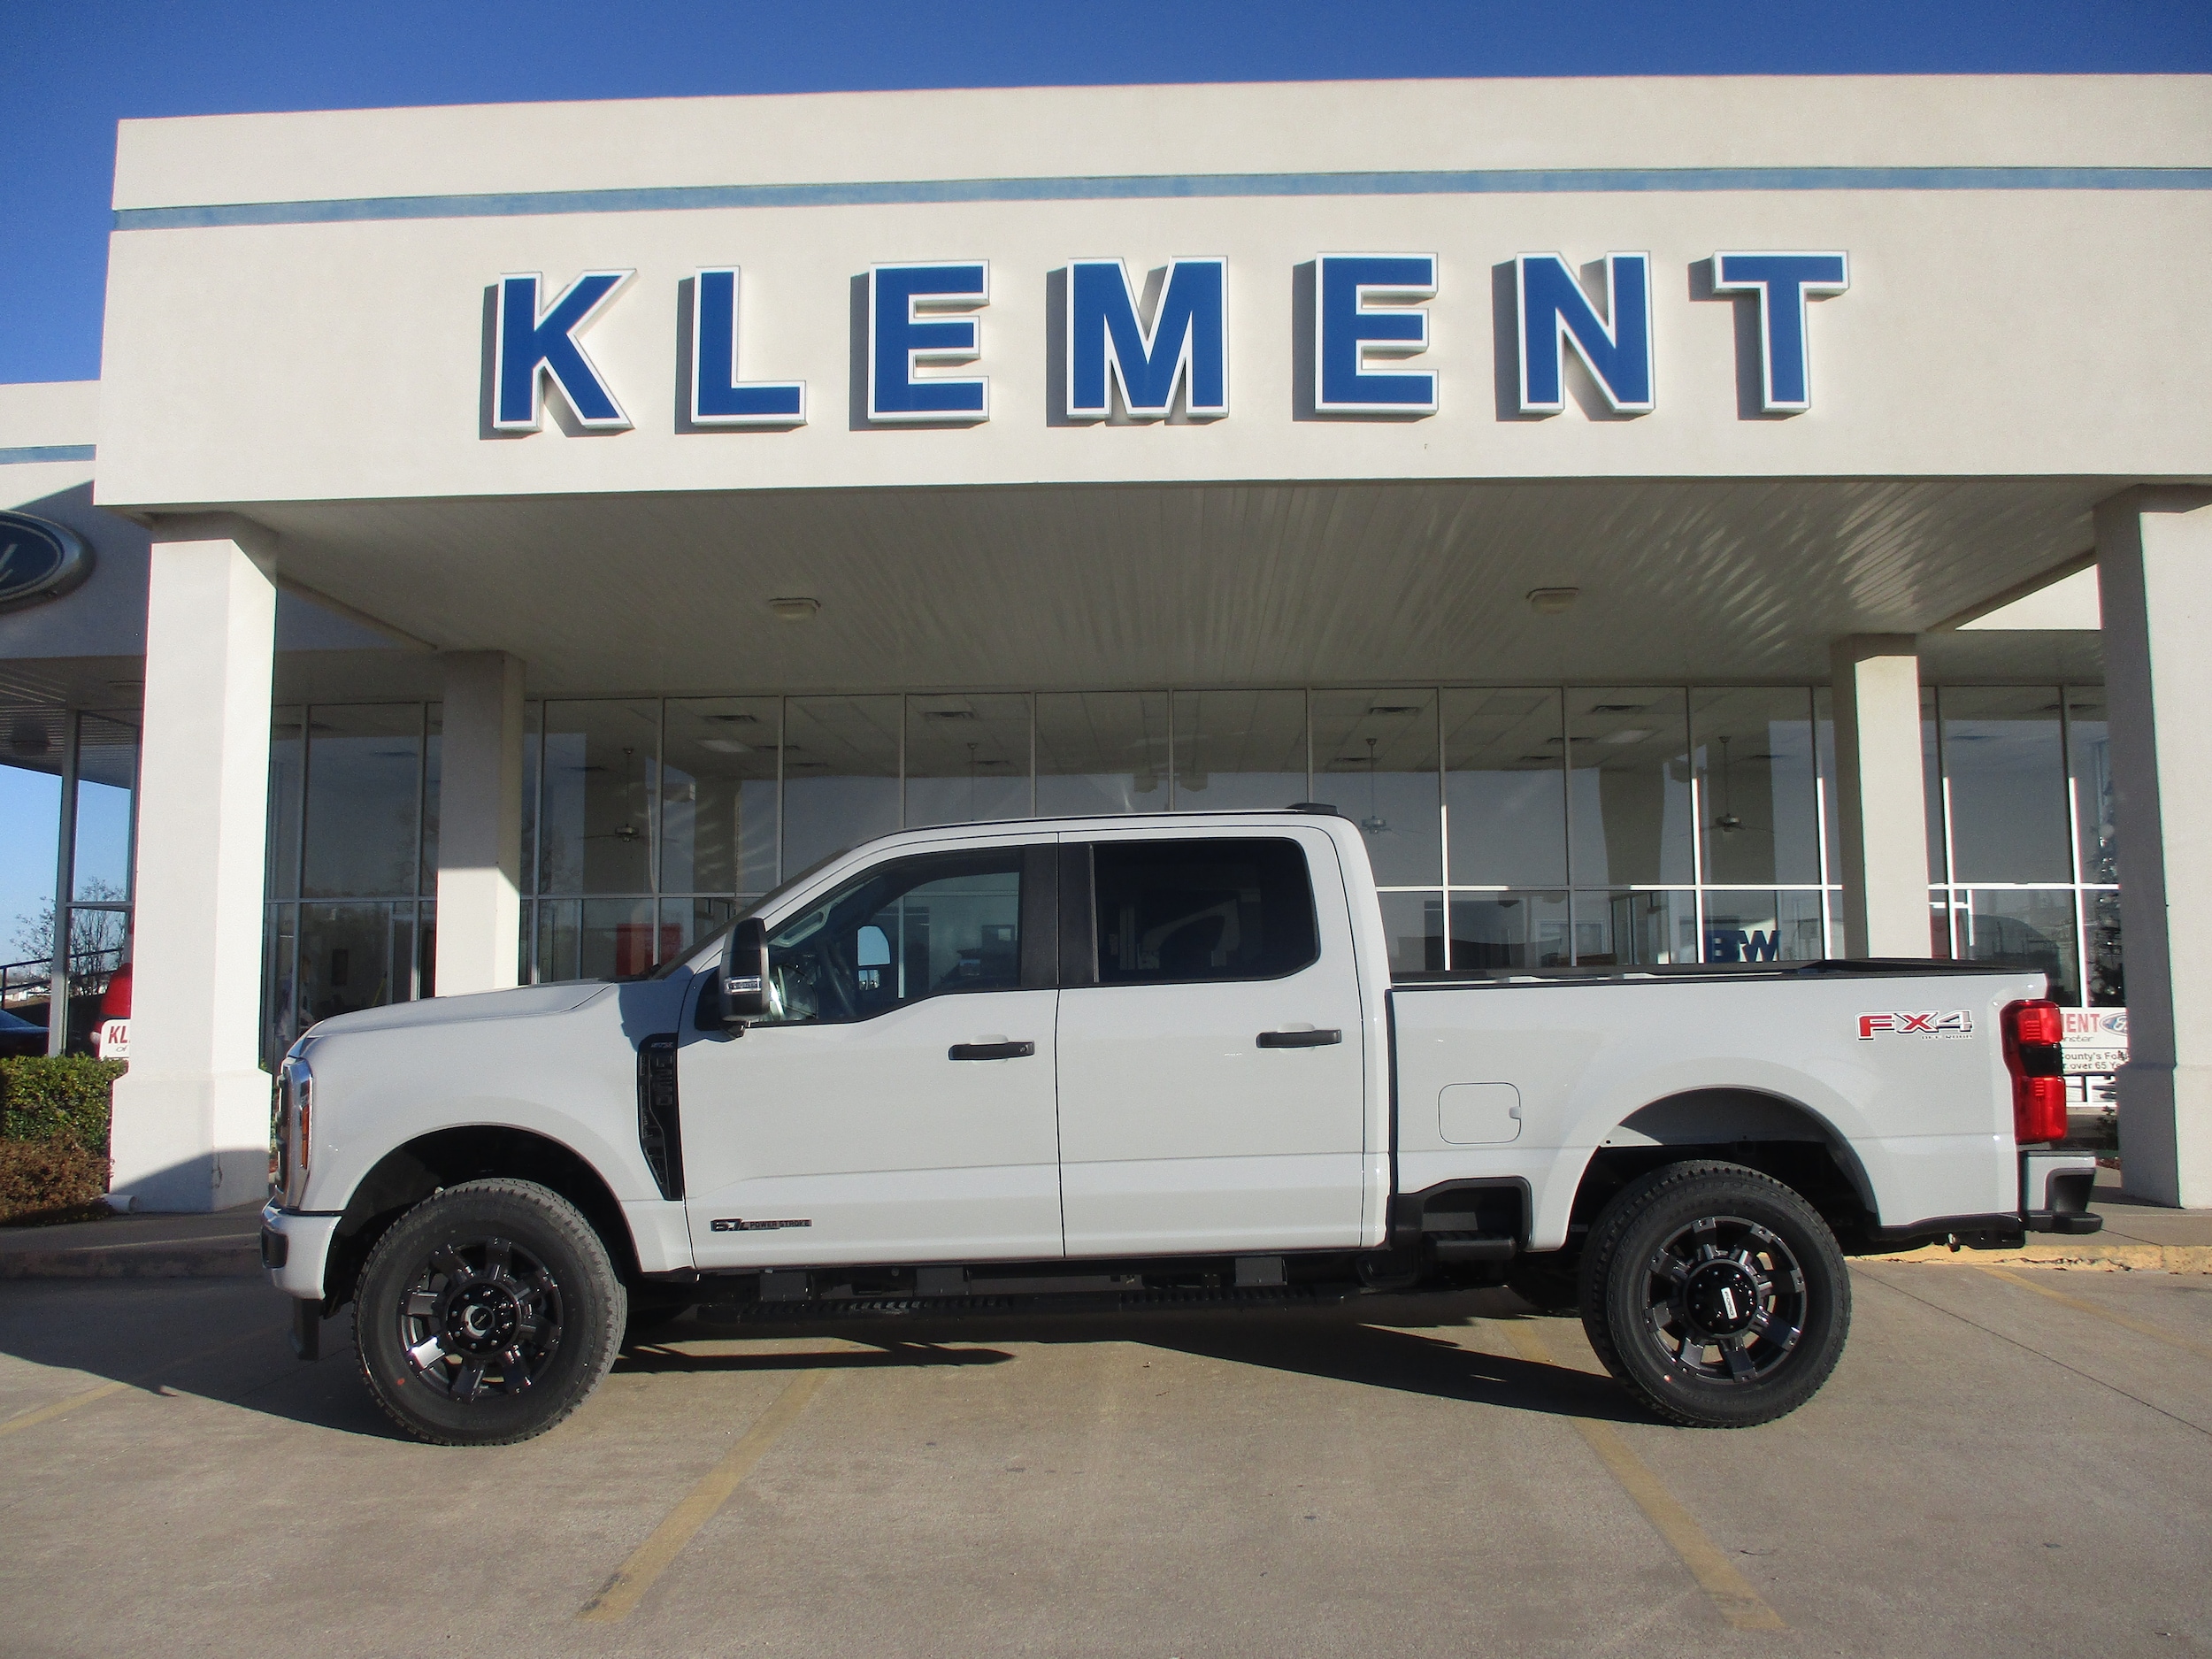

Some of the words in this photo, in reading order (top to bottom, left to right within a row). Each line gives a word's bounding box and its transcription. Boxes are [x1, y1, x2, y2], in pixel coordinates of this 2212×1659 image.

[483, 249, 1849, 435] KLEMENT
[108, 1025, 131, 1044] KL
[1855, 1010, 1973, 1041] FX4
[2062, 1052, 2102, 1062] ounty's
